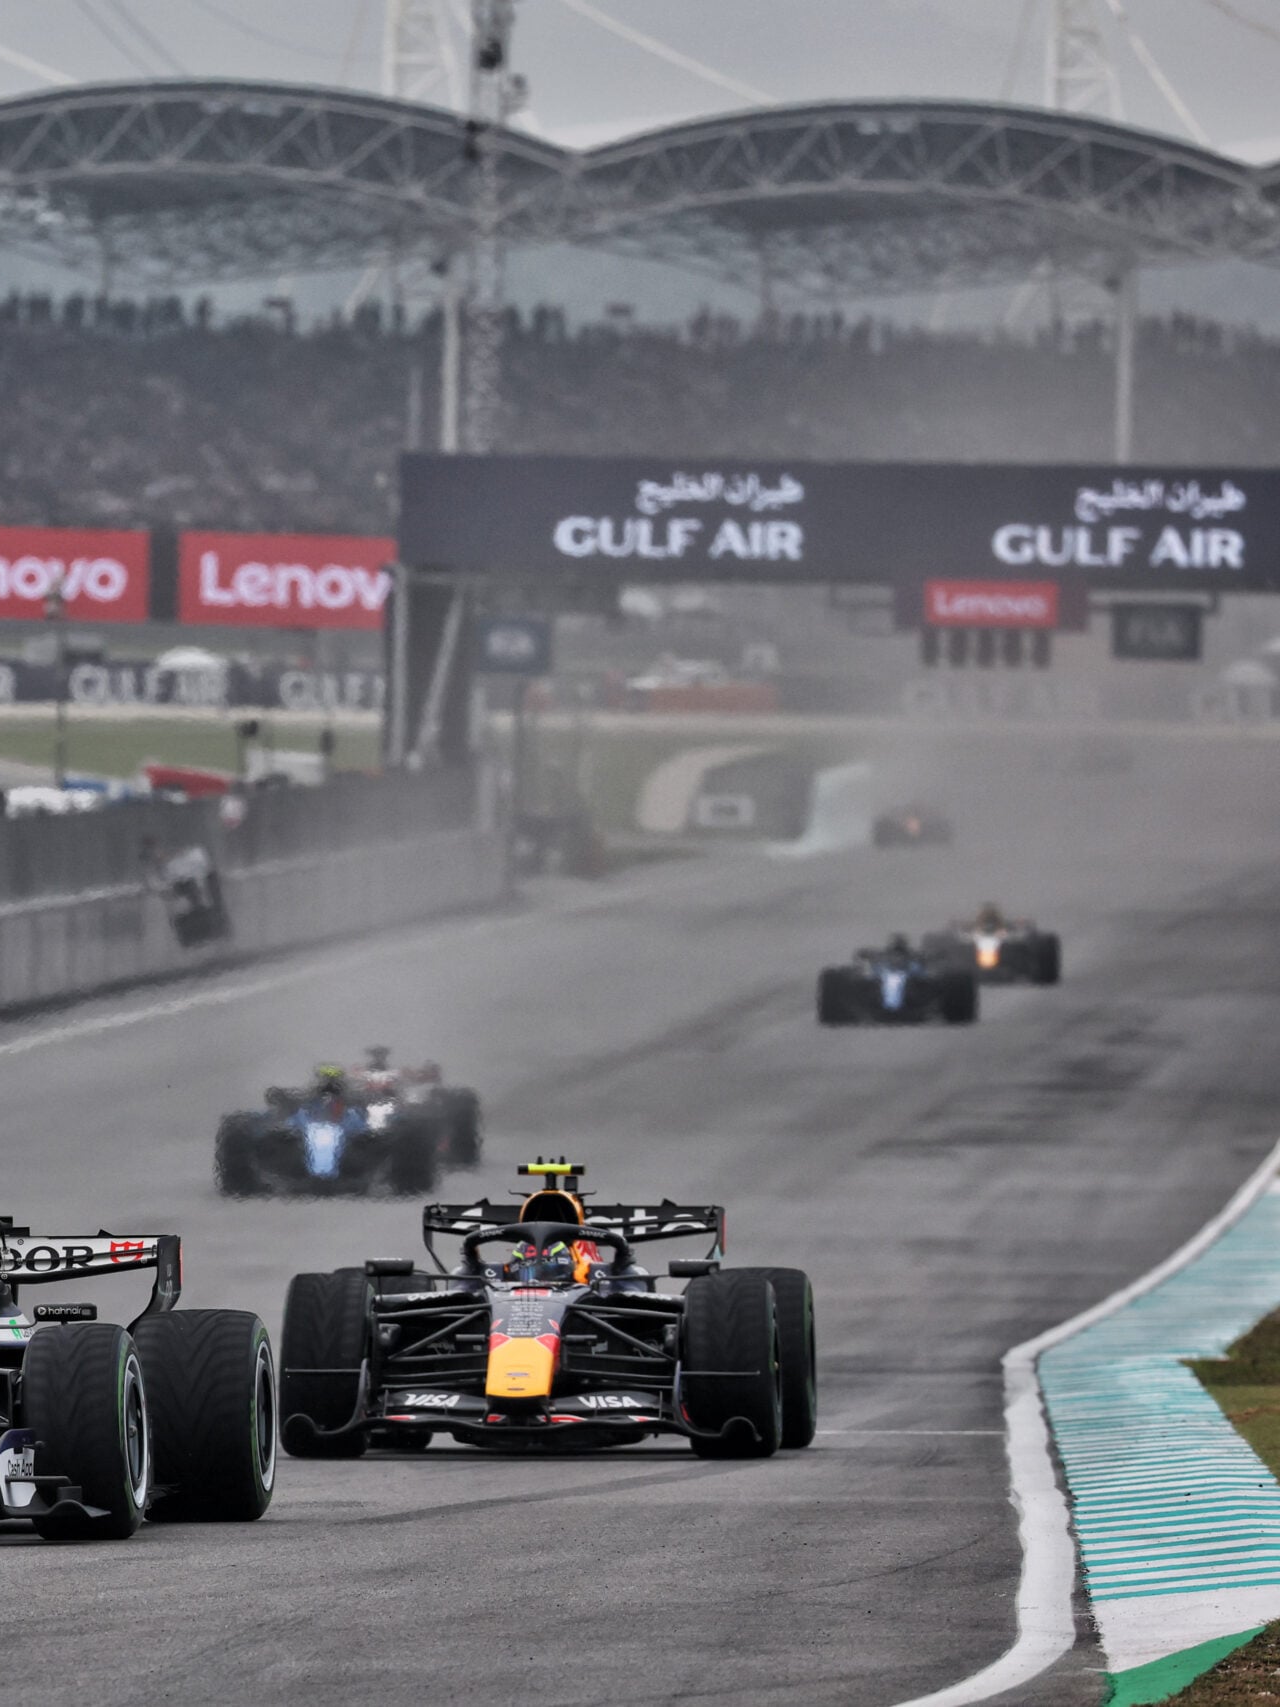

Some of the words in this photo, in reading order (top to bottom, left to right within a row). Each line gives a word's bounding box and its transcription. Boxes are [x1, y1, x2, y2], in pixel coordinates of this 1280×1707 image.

[553, 515, 704, 558] GULF
[707, 517, 803, 560] AIR
[991, 523, 1141, 566] GULF
[1148, 524, 1246, 569] AIR
[199, 551, 395, 611] Lenov
[932, 587, 1051, 617] Lenovo
[48, 1306, 81, 1315] hahnair
[404, 1393, 461, 1408] VISA
[577, 1395, 642, 1409] VISA
[7, 1459, 21, 1476] Cash
